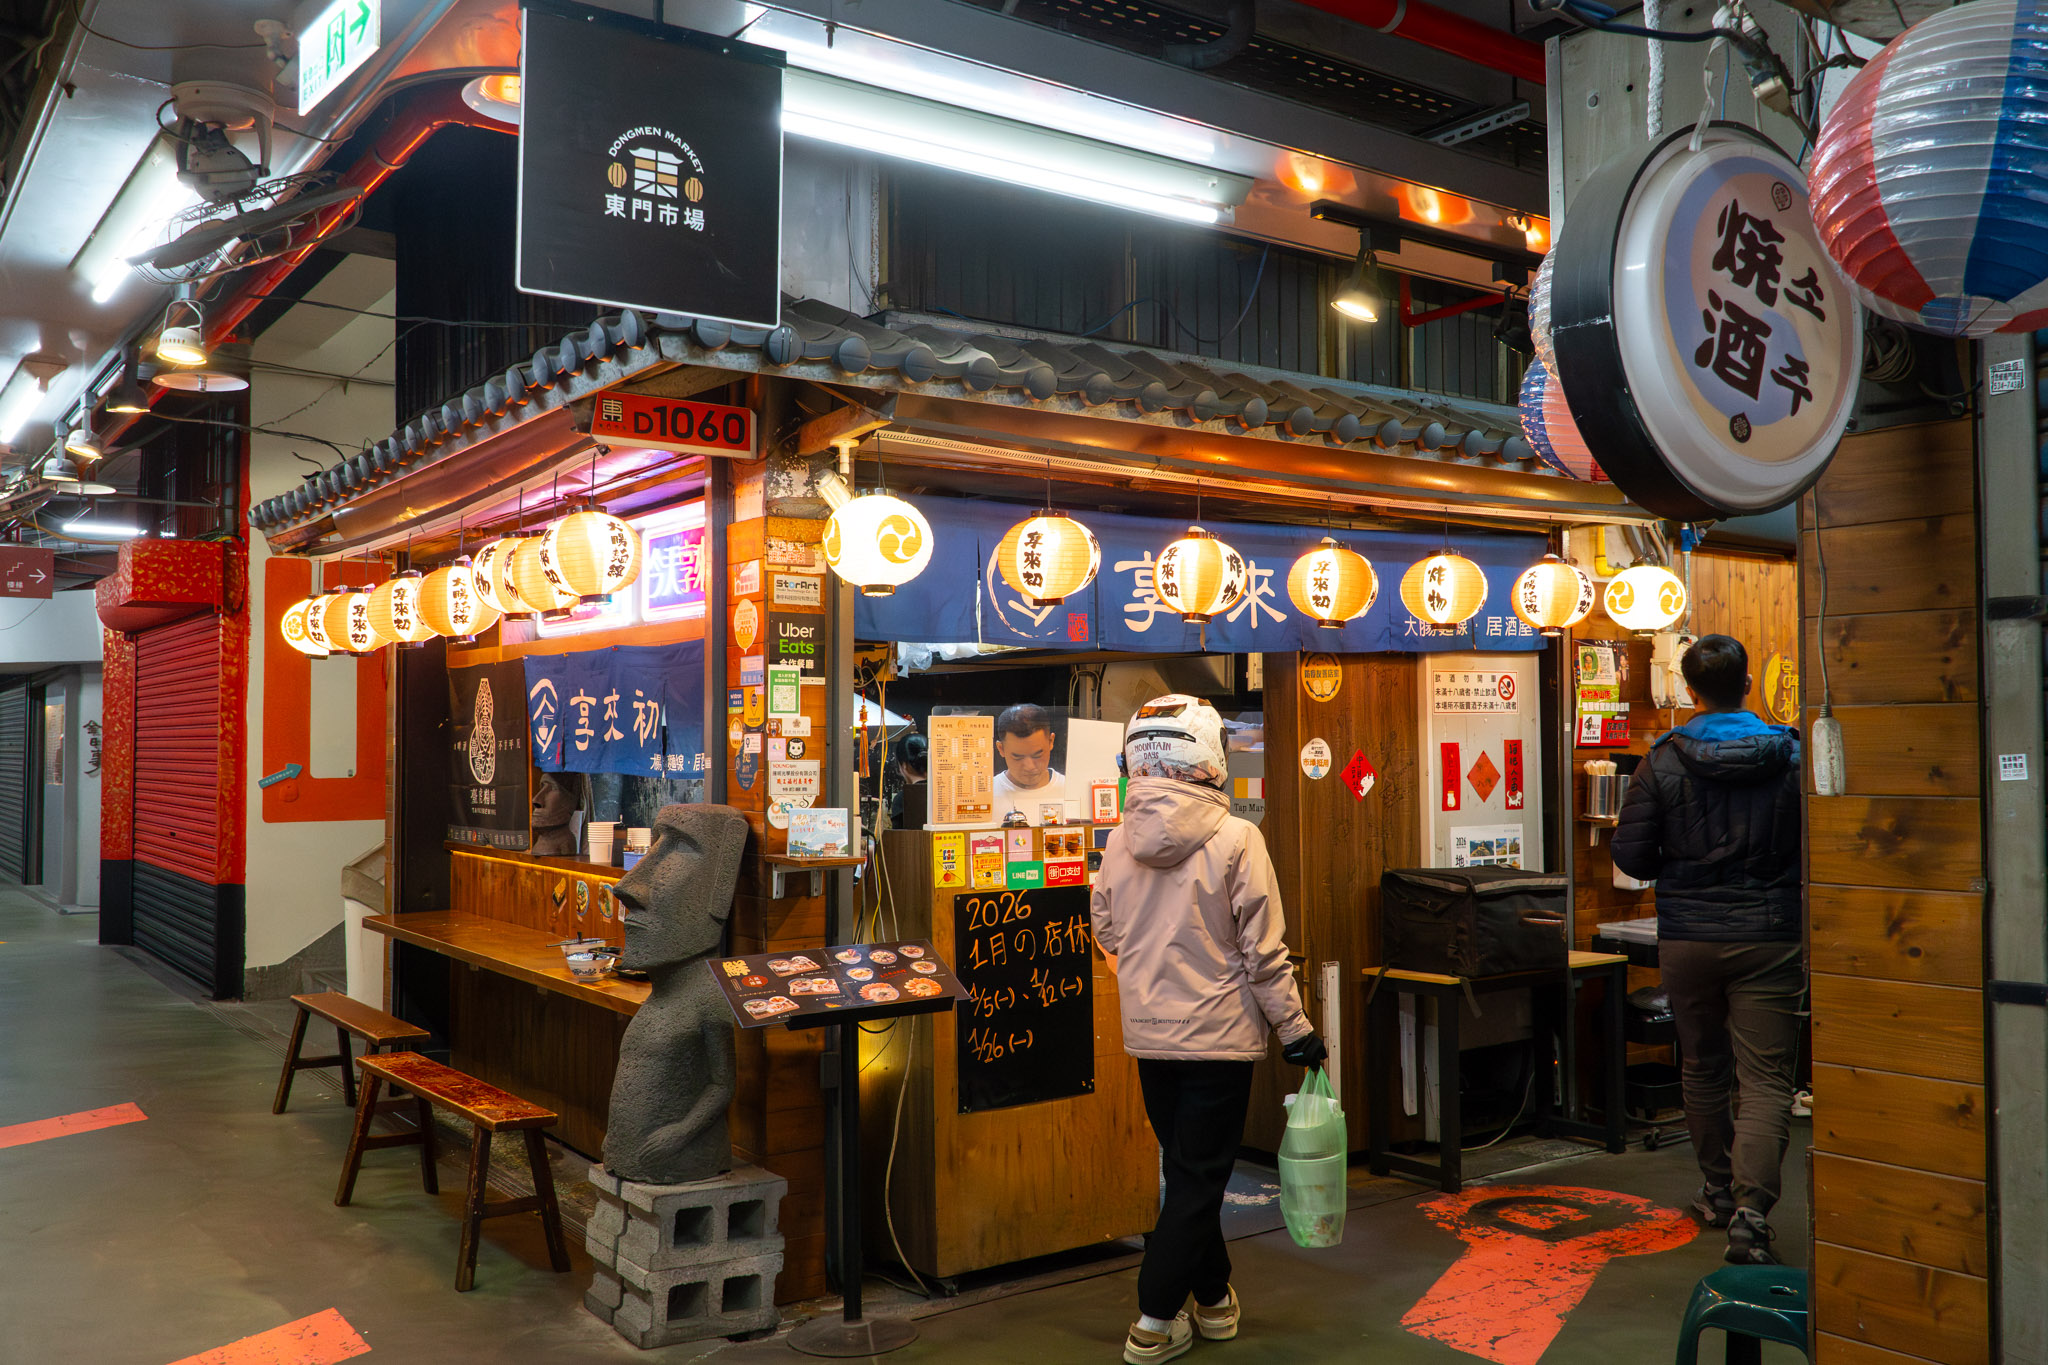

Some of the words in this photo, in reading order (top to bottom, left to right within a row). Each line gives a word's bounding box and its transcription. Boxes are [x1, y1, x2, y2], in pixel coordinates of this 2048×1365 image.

[608, 126, 662, 157] DONGMEN
[664, 130, 704, 174] MARKET
[604, 193, 705, 232] 東門市場
[1770, 266, 1826, 417] 소주
[633, 405, 745, 445] D1060
[1022, 530, 1044, 588] 享來初
[1162, 546, 1179, 598] 享來初
[1221, 552, 1243, 605] 炸物
[776, 579, 818, 590] StorArt
[1312, 560, 1331, 609] 享來初
[1427, 564, 1448, 612] 炸物
[779, 622, 815, 638] Uber
[779, 639, 815, 654] Eats
[1435, 674, 1497, 683] 飲酒勿開車
[1134, 742, 1172, 752] MOUNTAIN
[1144, 752, 1160, 760] DAYS
[1234, 803, 1247, 814] Tap
[1249, 804, 1265, 812] Mar
[1456, 837, 1466, 846] 2026
[1012, 872, 1026, 880] LINE
[1027, 871, 1038, 880] Pay
[1048, 866, 1081, 879] 街口支付
[966, 889, 1032, 931] 2026
[969, 914, 1090, 970] 1月の店休
